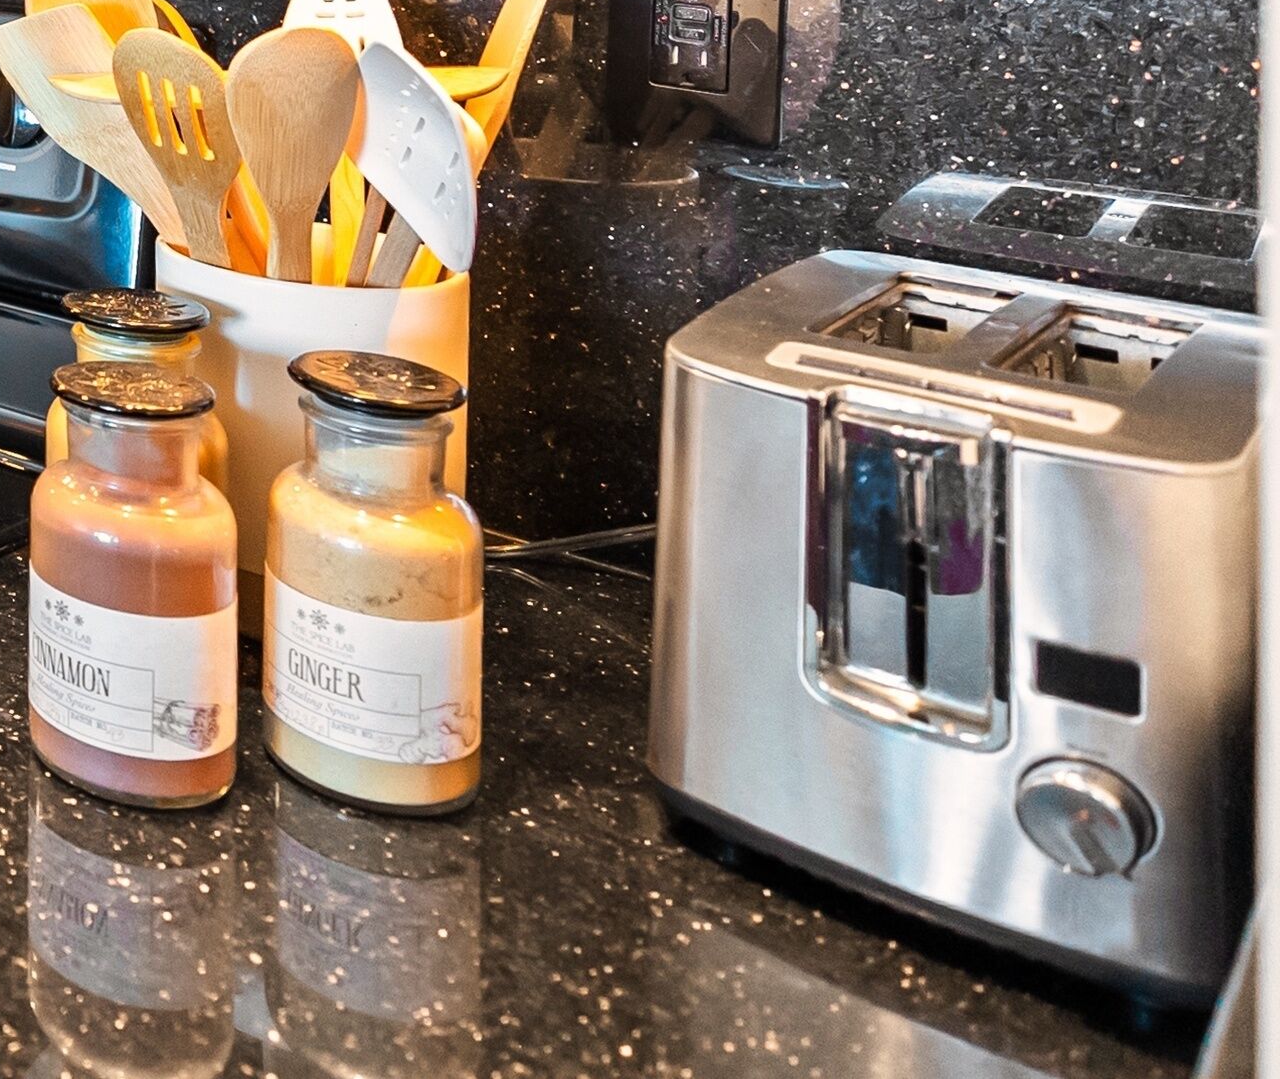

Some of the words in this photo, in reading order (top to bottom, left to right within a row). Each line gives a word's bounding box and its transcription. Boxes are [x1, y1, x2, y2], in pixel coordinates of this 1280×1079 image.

[32, 631, 111, 697] CINNAMON
[74, 630, 93, 646] LAB
[288, 647, 366, 704] GINGER
